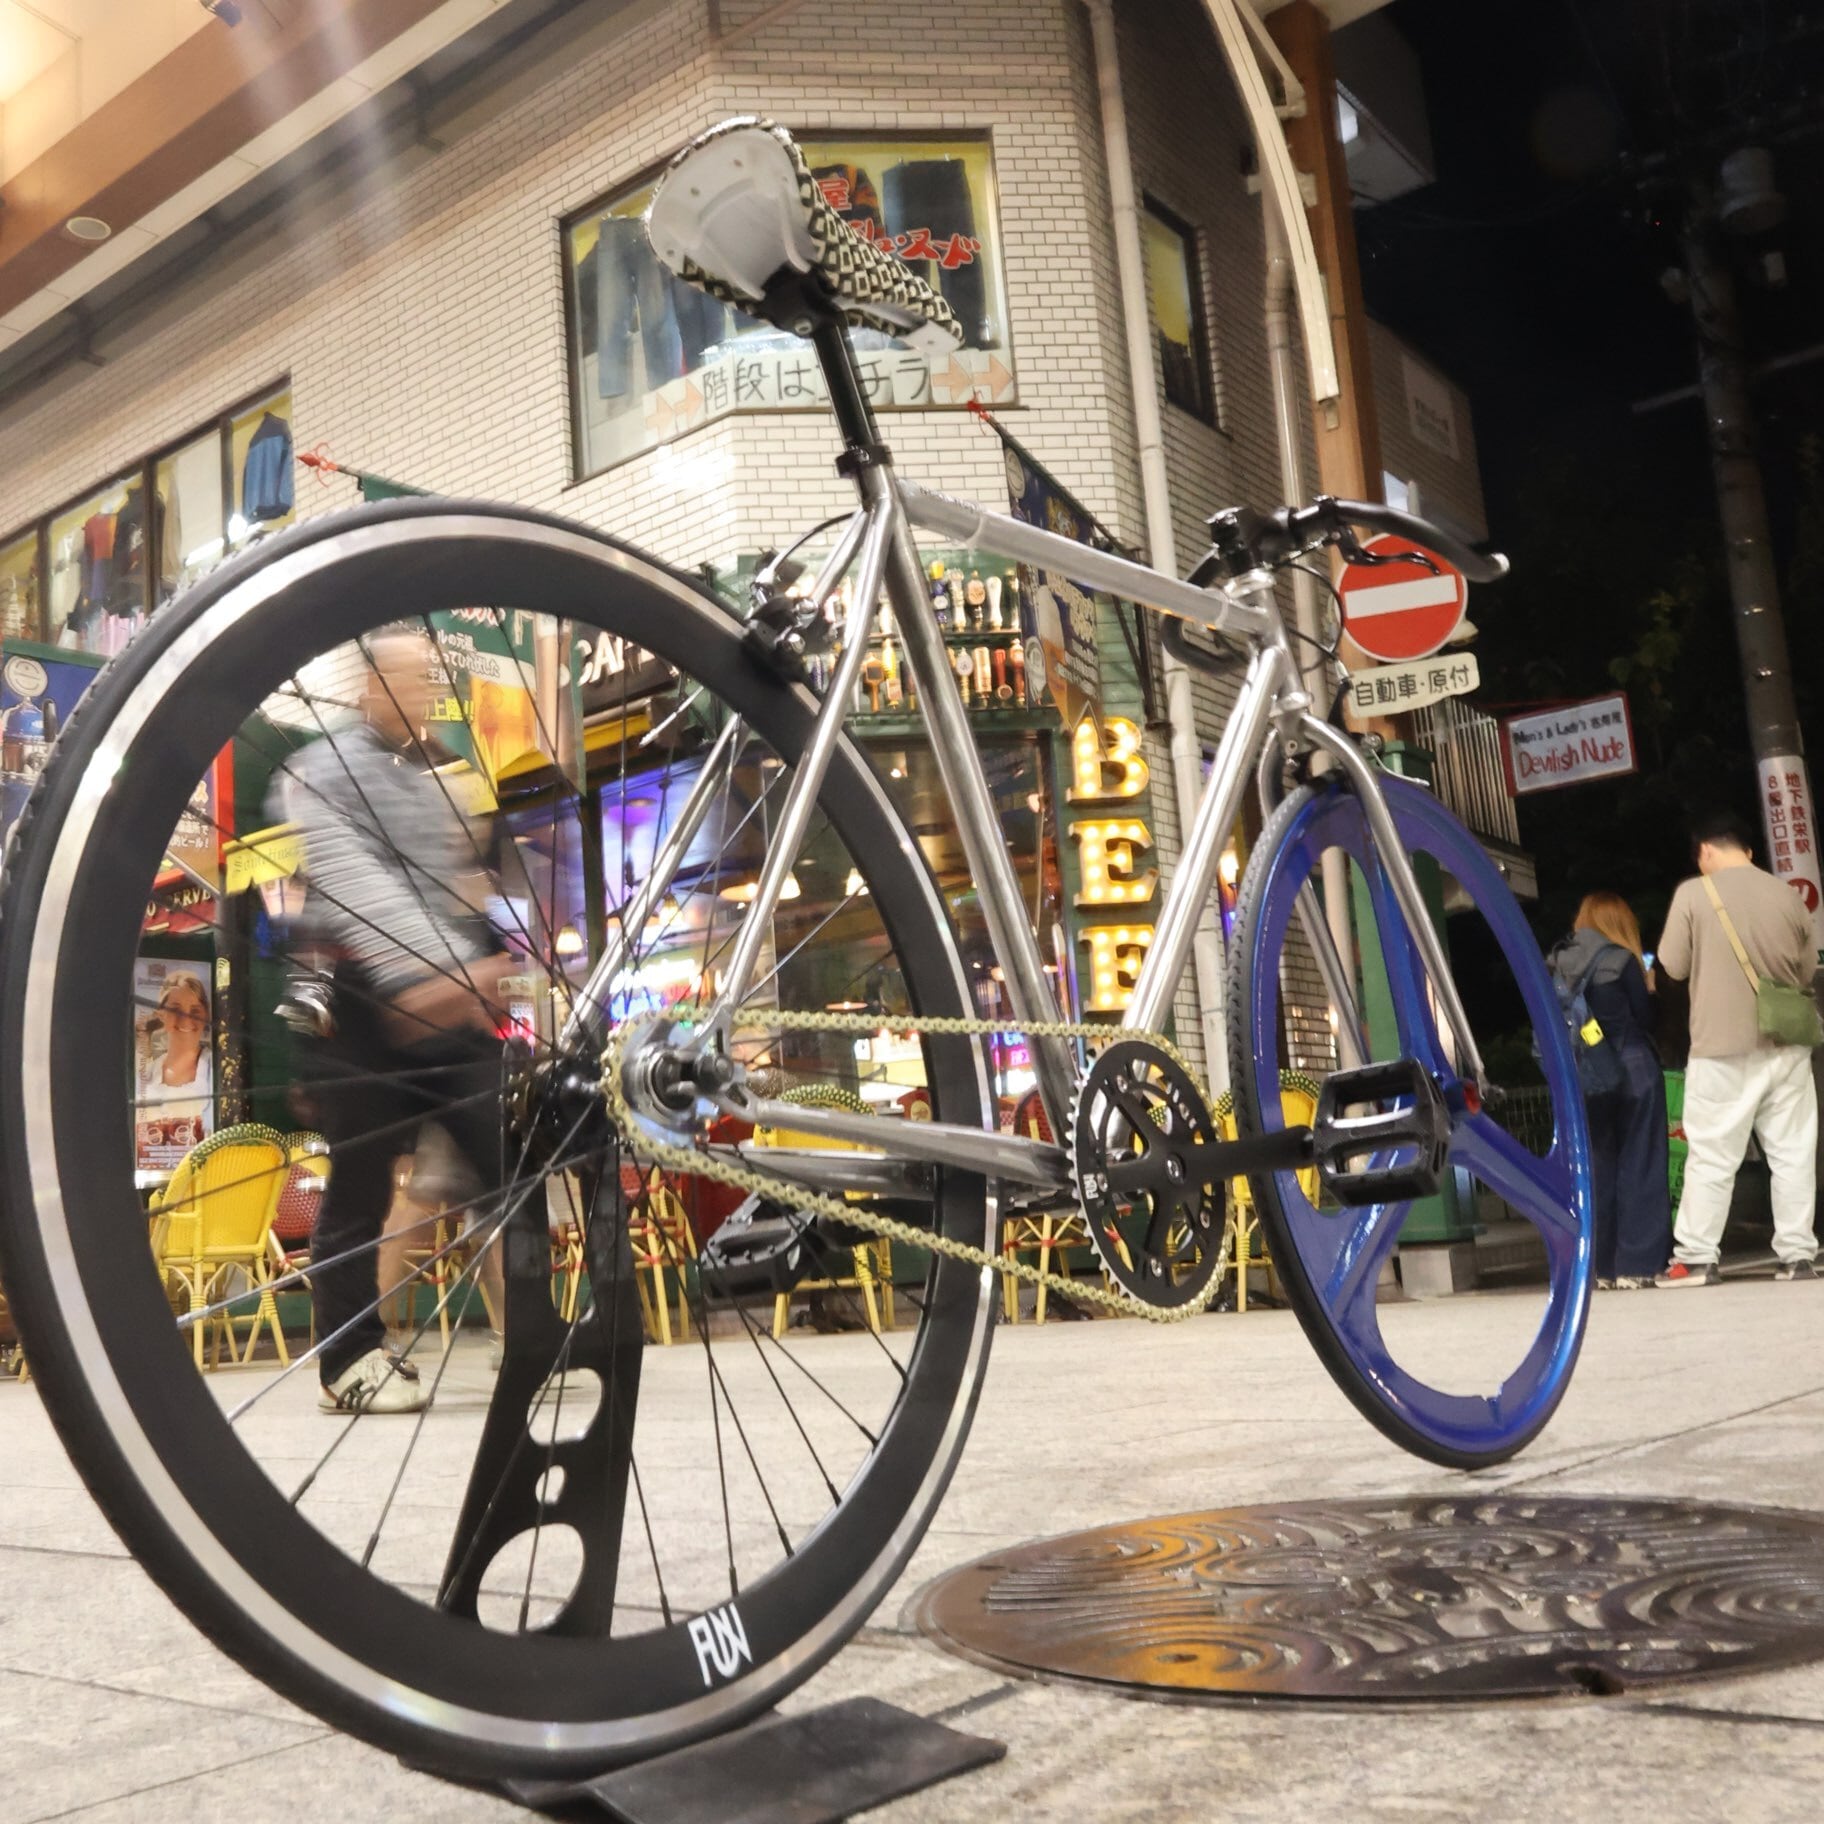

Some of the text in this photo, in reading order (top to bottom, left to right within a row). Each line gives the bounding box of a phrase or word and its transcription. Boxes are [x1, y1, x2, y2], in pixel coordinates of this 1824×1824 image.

[702, 357, 929, 414] 階段はチラ
[1355, 664, 1470, 707] 自動車・原付
[1519, 735, 1625, 778] Devilish Nude
